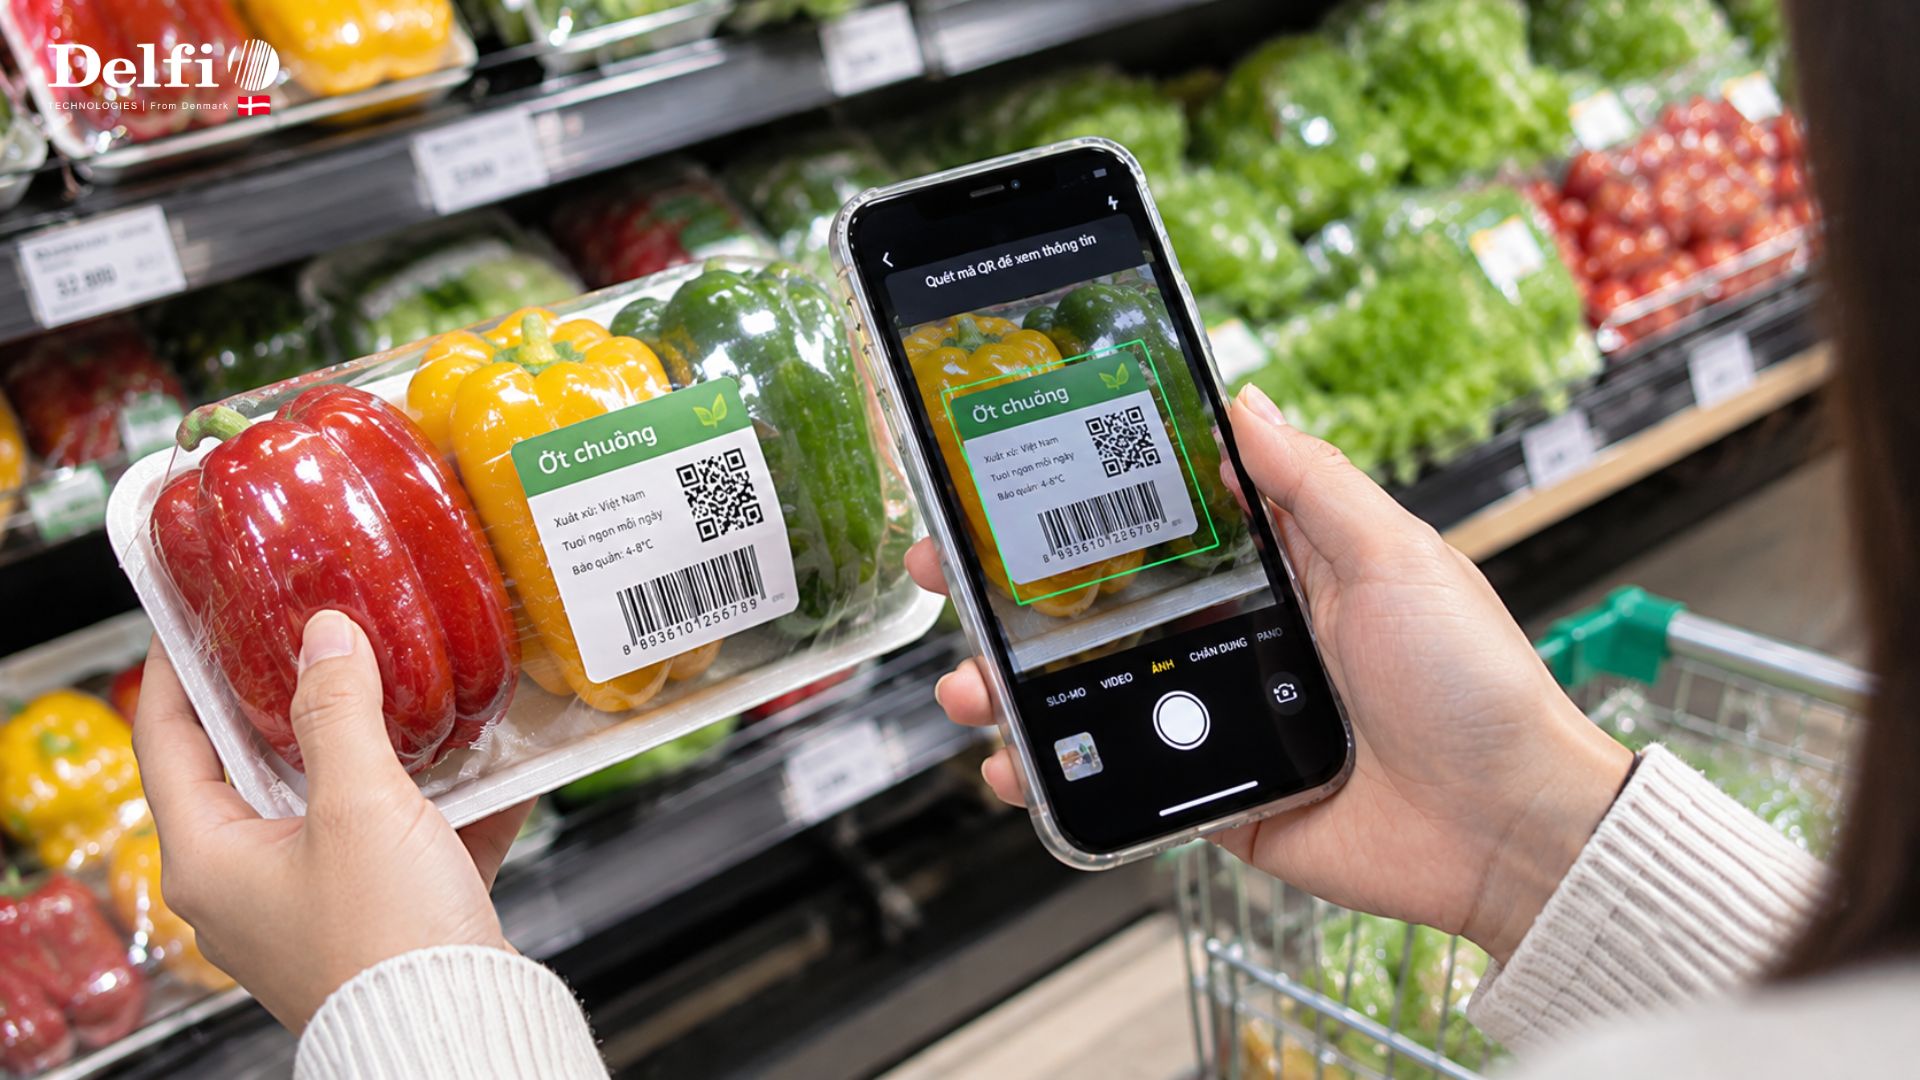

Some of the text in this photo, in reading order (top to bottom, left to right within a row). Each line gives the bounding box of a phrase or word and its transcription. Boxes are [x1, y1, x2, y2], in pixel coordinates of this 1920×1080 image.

[925, 270, 956, 288] Quét
[977, 260, 998, 275] QR
[1015, 249, 1042, 265] xem
[1078, 233, 1097, 247] tin
[621, 490, 646, 504] Nam
[588, 527, 616, 543] ngon
[622, 644, 631, 656] 8
[1100, 672, 1133, 690] VIDEO
[1220, 637, 1248, 654] DUNG
[1256, 627, 1284, 642] PANO
